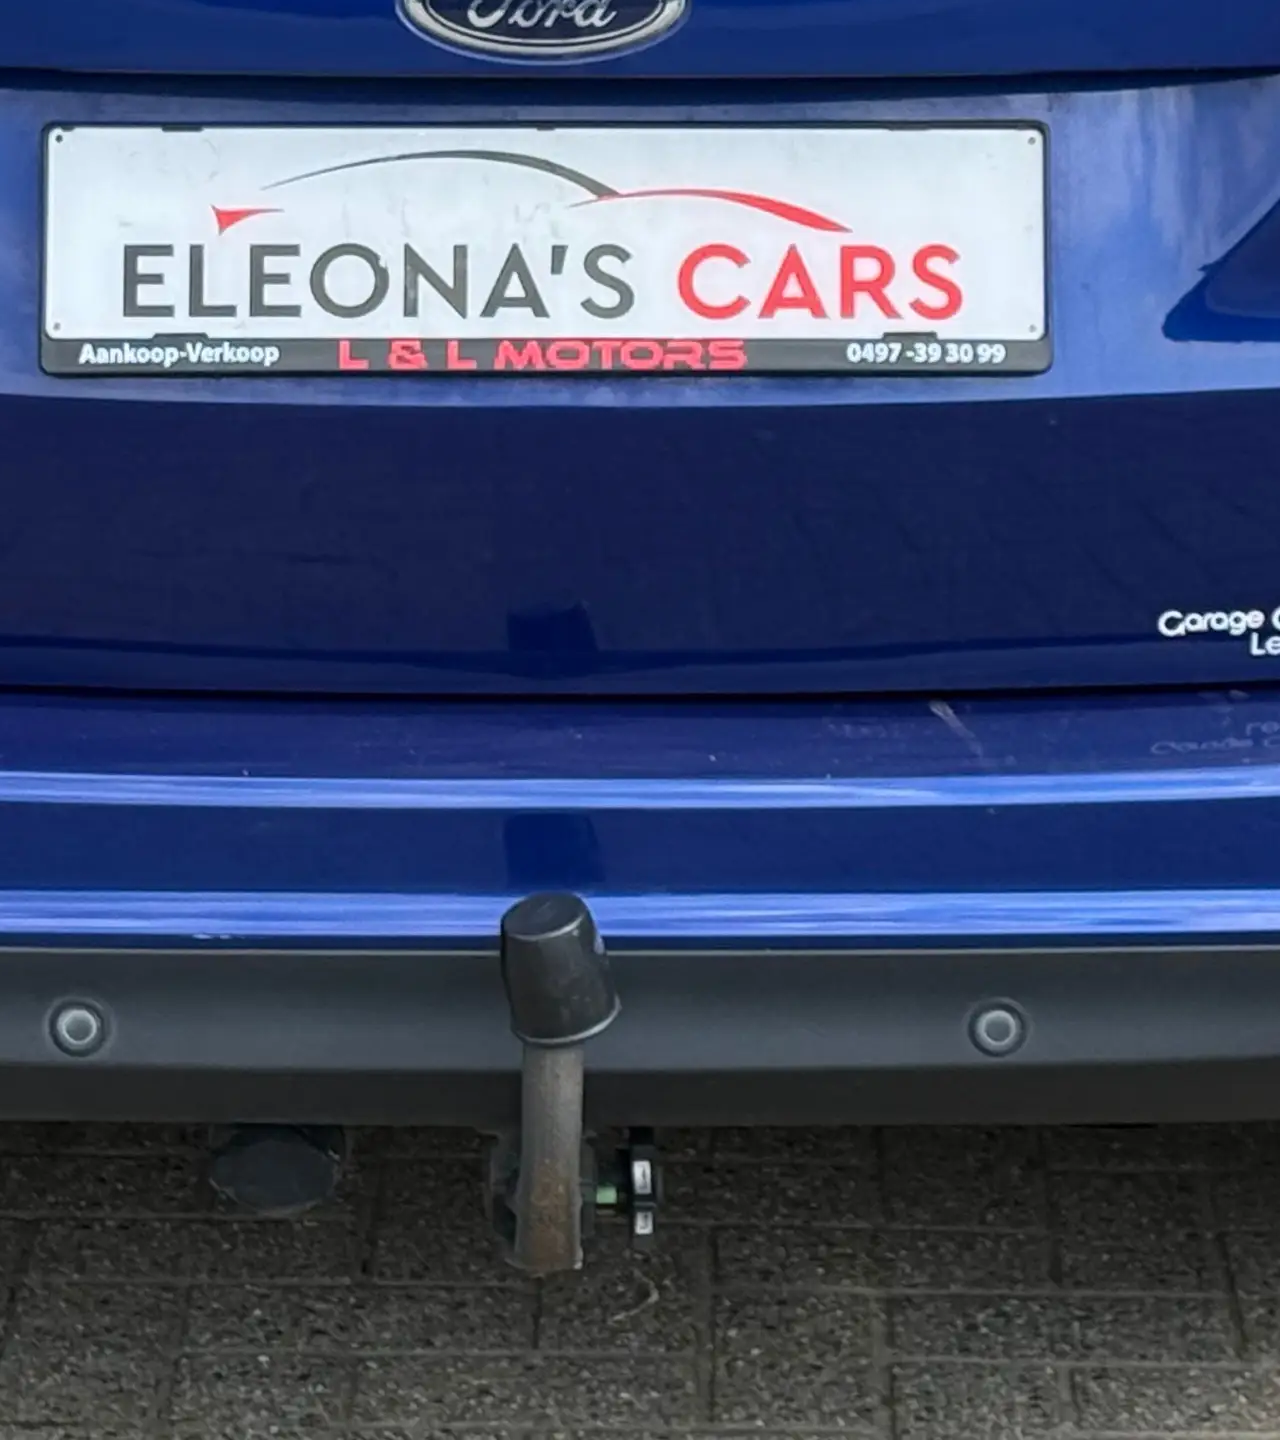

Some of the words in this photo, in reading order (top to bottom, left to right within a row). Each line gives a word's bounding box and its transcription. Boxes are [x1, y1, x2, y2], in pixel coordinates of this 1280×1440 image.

[122, 242, 635, 319] ELEONA'S
[676, 242, 964, 320] CARS
[78, 341, 281, 367] Aankoop-Verkoop
[338, 340, 370, 371] L
[388, 340, 428, 371] &
[446, 340, 478, 371] L
[493, 340, 748, 371] MOTORS
[1157, 610, 1265, 637] Garage
